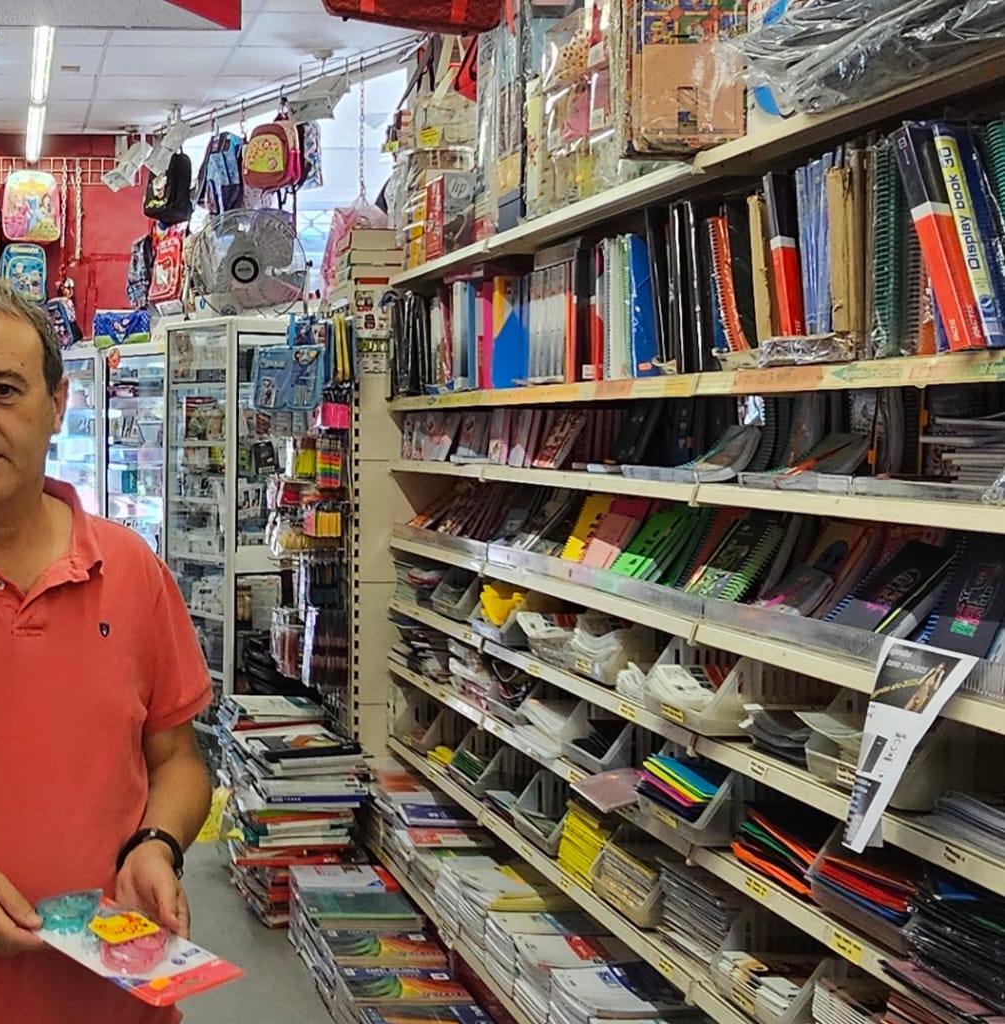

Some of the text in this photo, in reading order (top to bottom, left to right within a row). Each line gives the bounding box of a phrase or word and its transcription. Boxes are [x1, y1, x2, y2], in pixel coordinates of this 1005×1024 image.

[451, 178, 467, 197] hp
[939, 146, 980, 270] Display book 30
